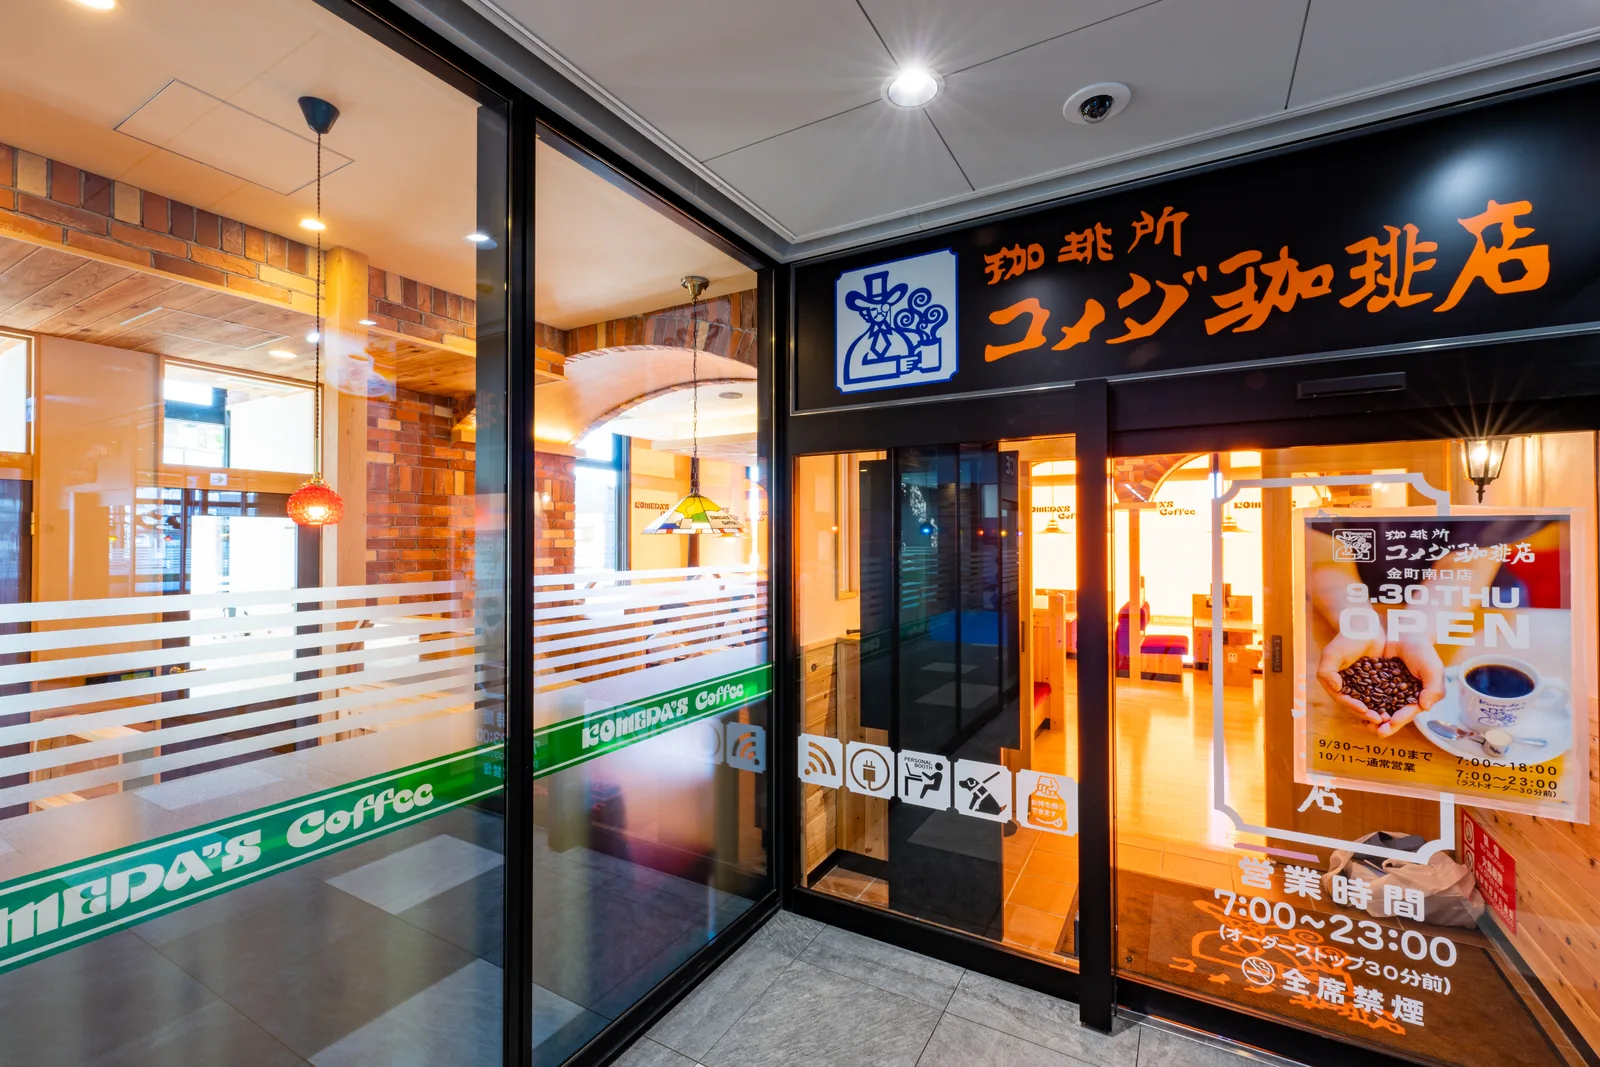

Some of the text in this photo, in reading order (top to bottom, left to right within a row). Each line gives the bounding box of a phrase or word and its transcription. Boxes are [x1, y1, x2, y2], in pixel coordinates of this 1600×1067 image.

[984, 206, 1190, 285] 珈琲所
[984, 200, 1550, 363] コメダ珈琲店
[1385, 542, 1536, 565] コメダ珈琲店
[1386, 567, 1473, 581] 金町南口店
[1346, 583, 1520, 609] 9.30.THU
[1338, 607, 1531, 650] OPEN
[581, 684, 744, 750] KOMEDA'S Coffee
[904, 756, 932, 766] PERSONAL
[914, 763, 933, 771] BOOTH
[286, 783, 434, 848] Coffee
[1238, 856, 1425, 922] 営業時間
[1282, 967, 1425, 1027] 全席禁煙
